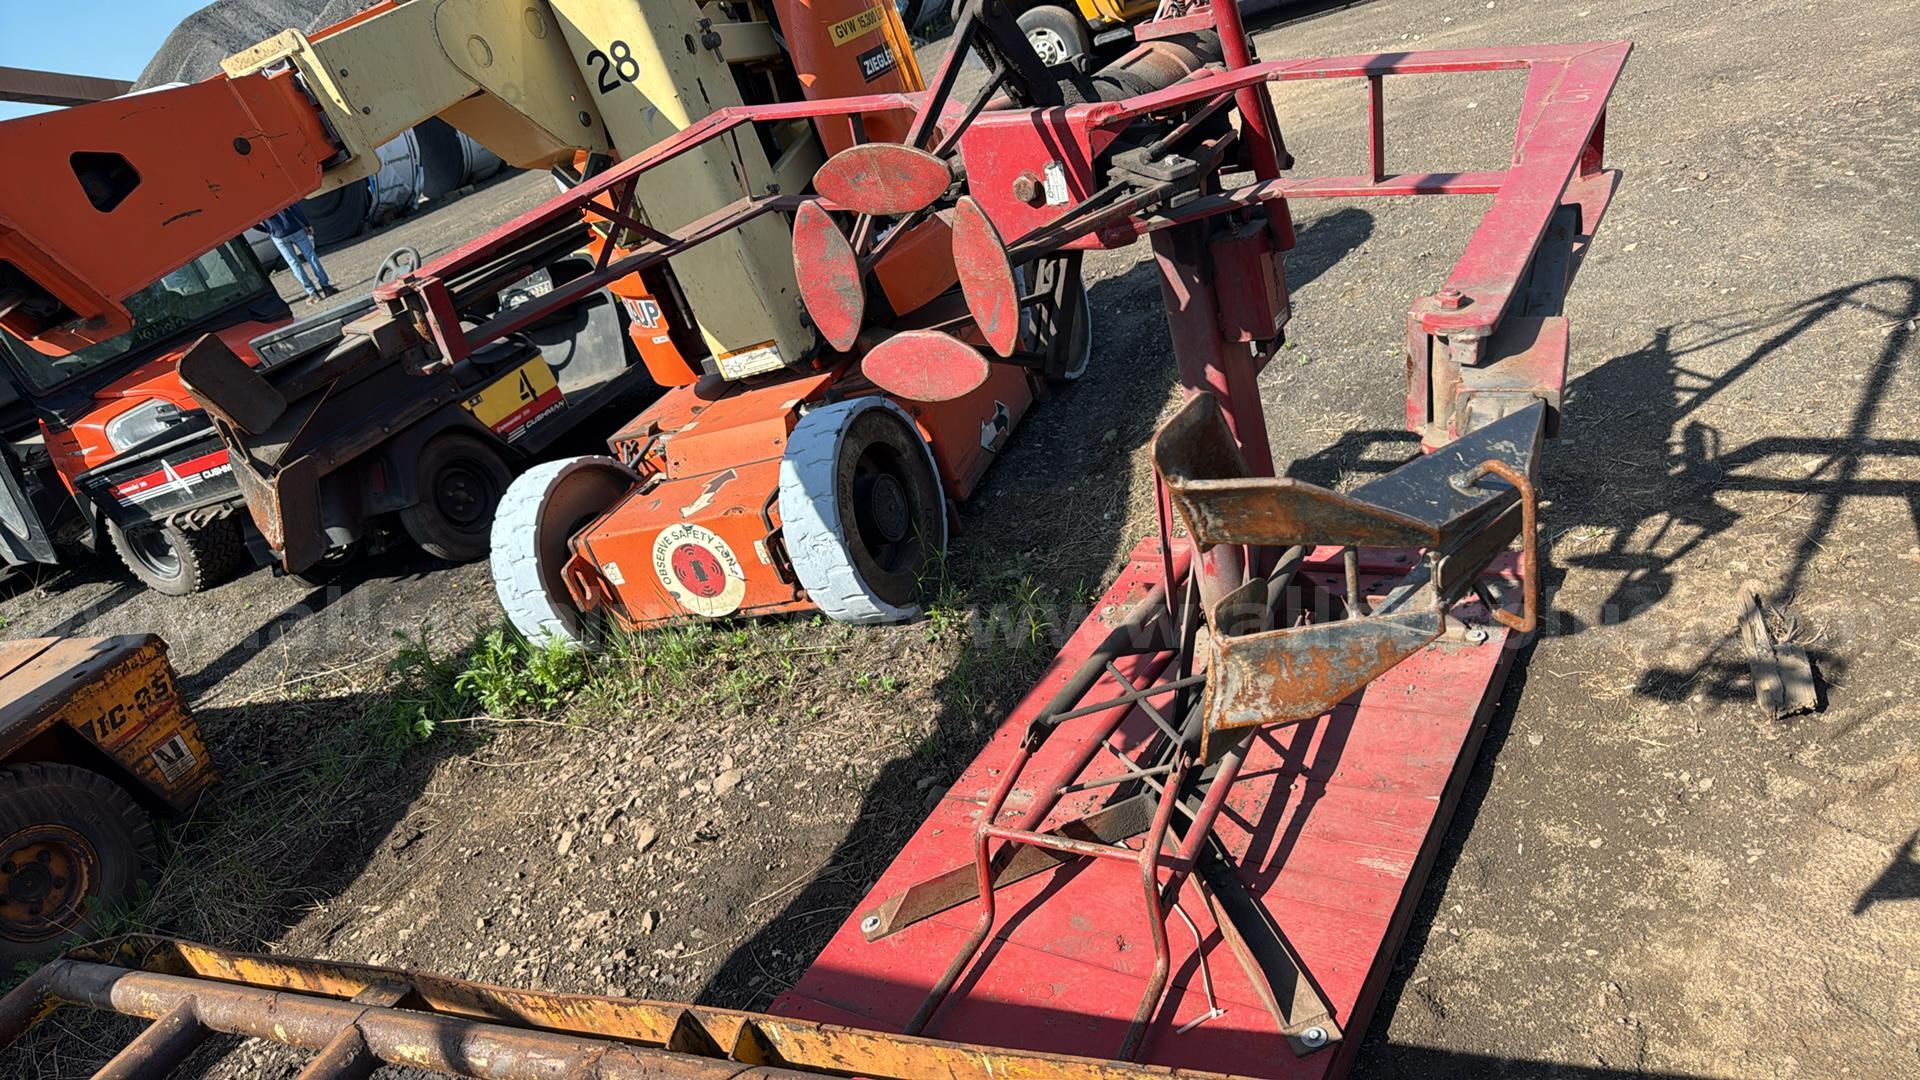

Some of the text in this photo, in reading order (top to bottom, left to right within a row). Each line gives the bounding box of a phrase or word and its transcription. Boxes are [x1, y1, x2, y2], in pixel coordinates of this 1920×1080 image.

[835, 19, 857, 39] GVW
[586, 40, 640, 95] 28
[519, 368, 539, 401] 4
[525, 400, 566, 429] CUSHMAN
[656, 536, 674, 586] OBSERVE
[671, 527, 715, 544] SAFETY
